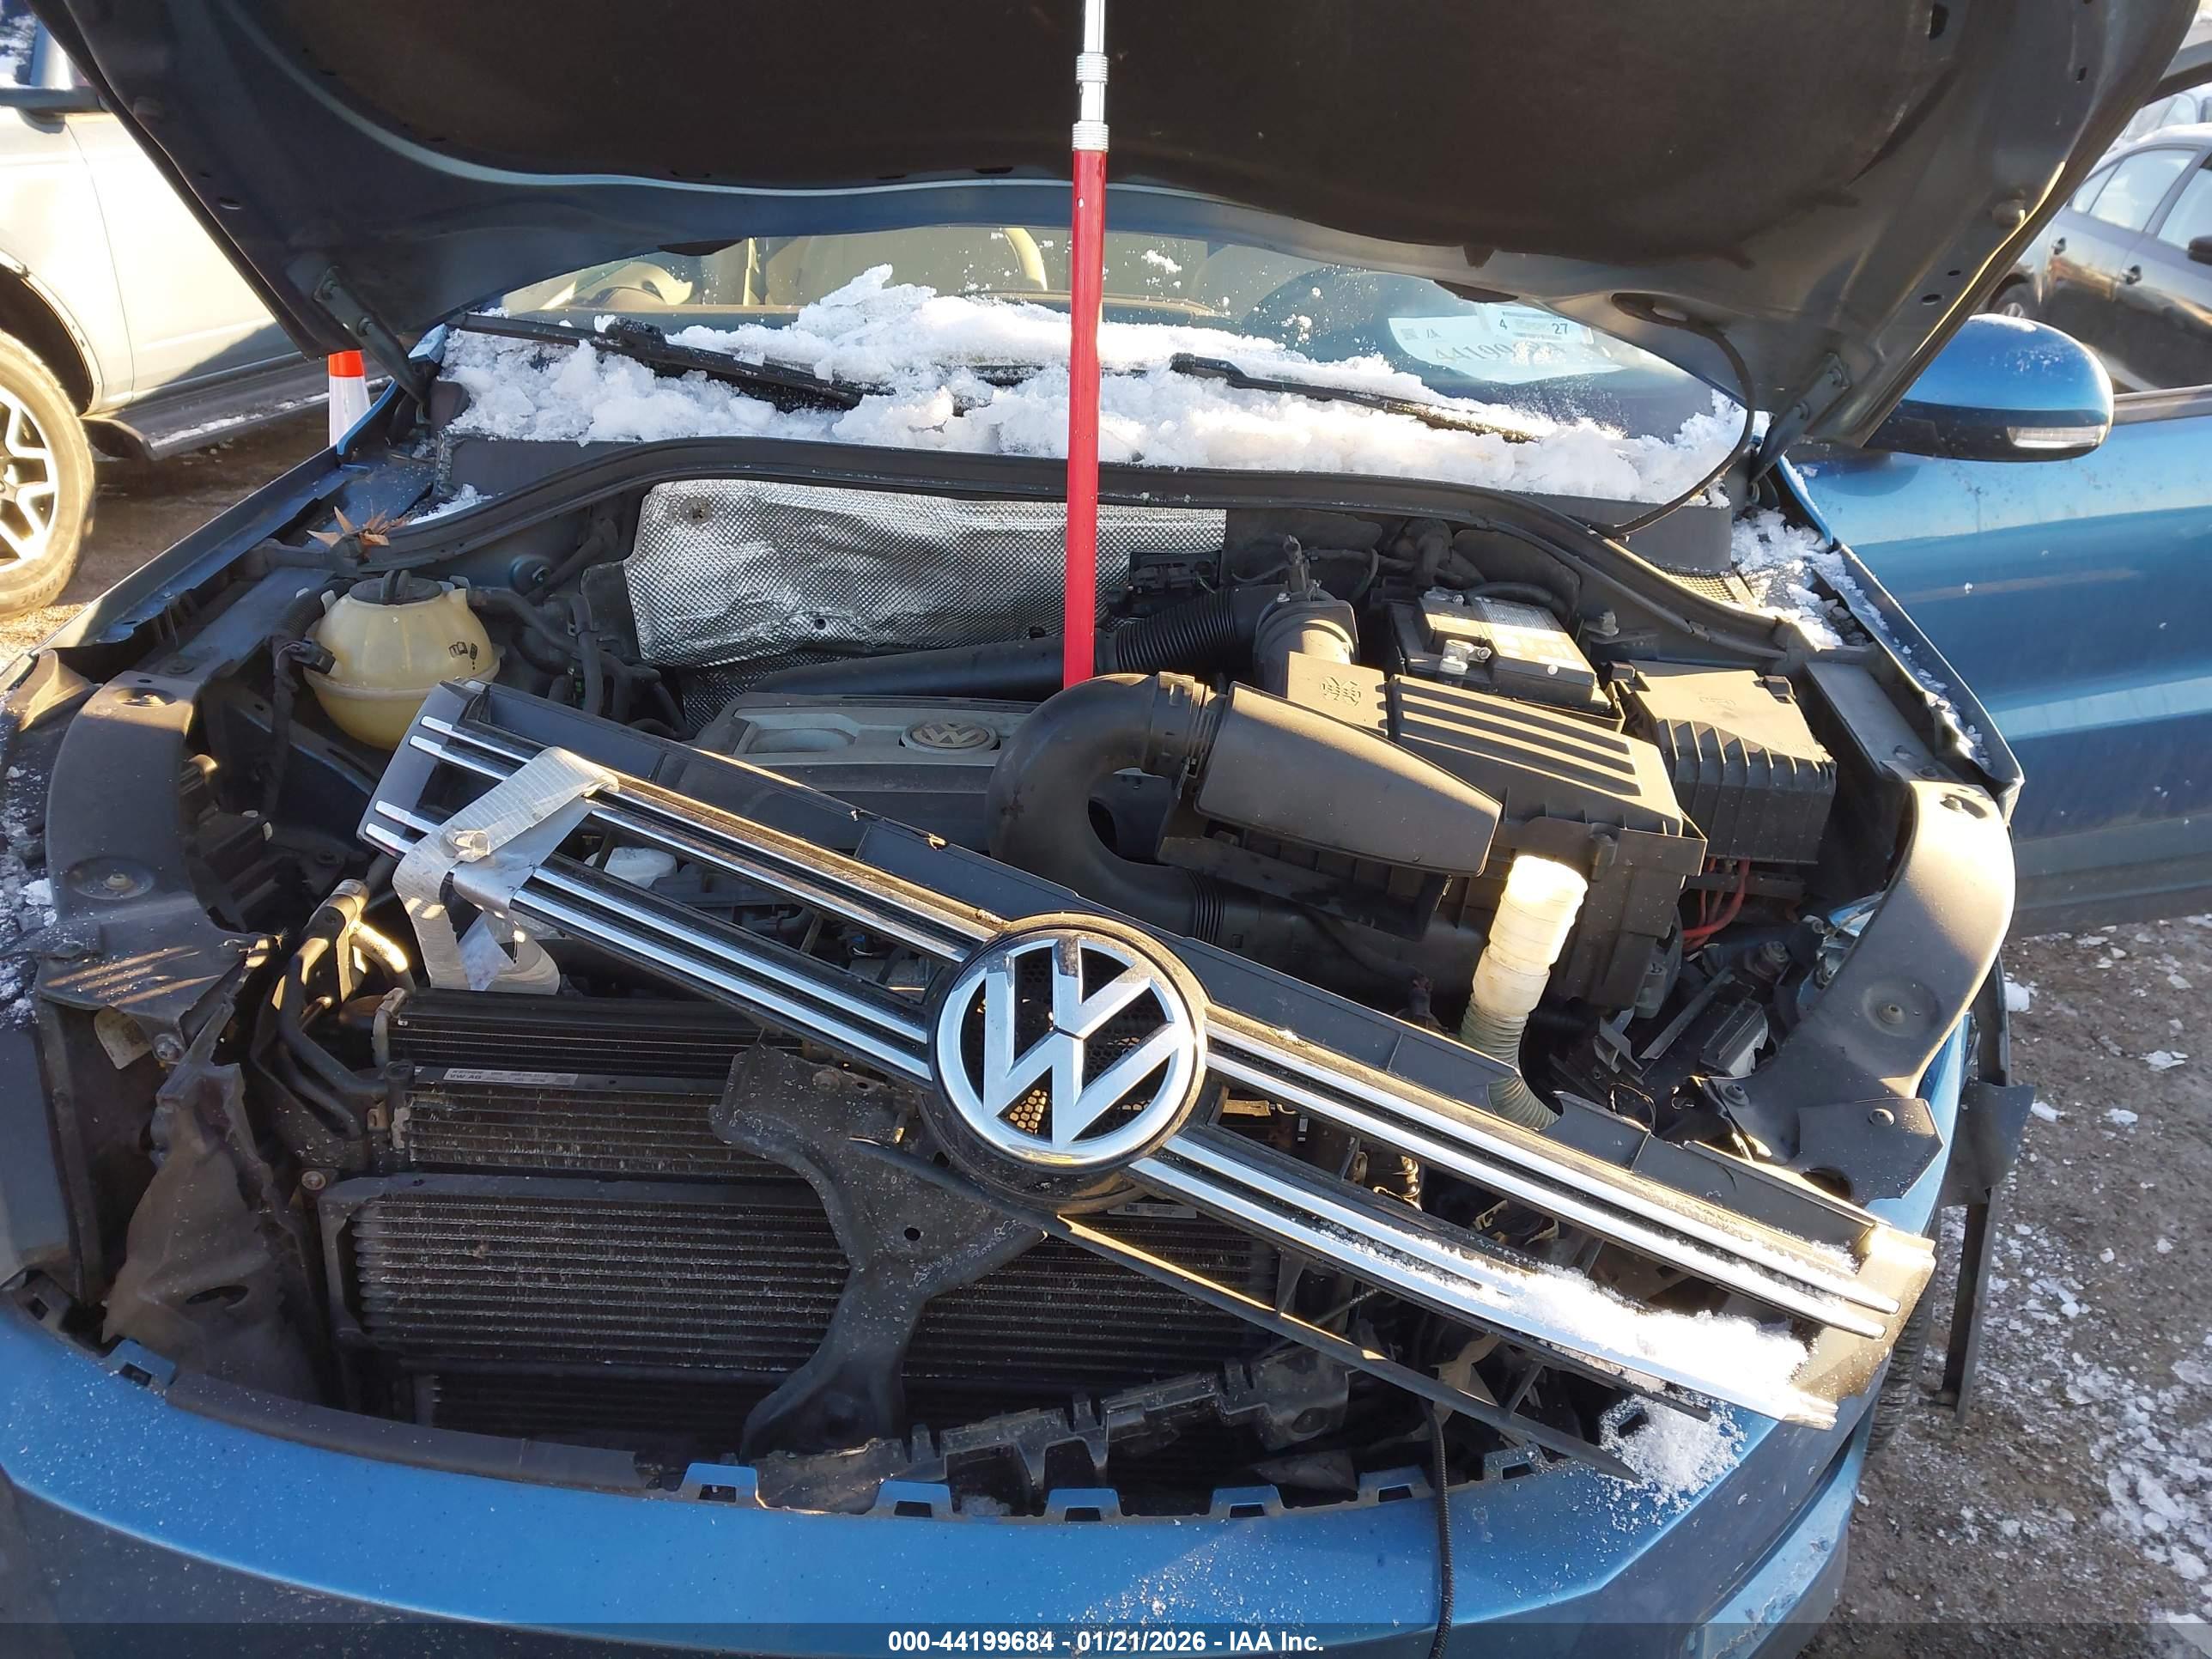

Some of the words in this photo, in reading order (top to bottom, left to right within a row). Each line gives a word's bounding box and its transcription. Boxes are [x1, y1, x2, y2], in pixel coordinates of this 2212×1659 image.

[1499, 319, 1508, 330] 4
[1552, 323, 1568, 335] 27
[912, 720, 989, 747] VW
[939, 932, 1194, 1159] VW
